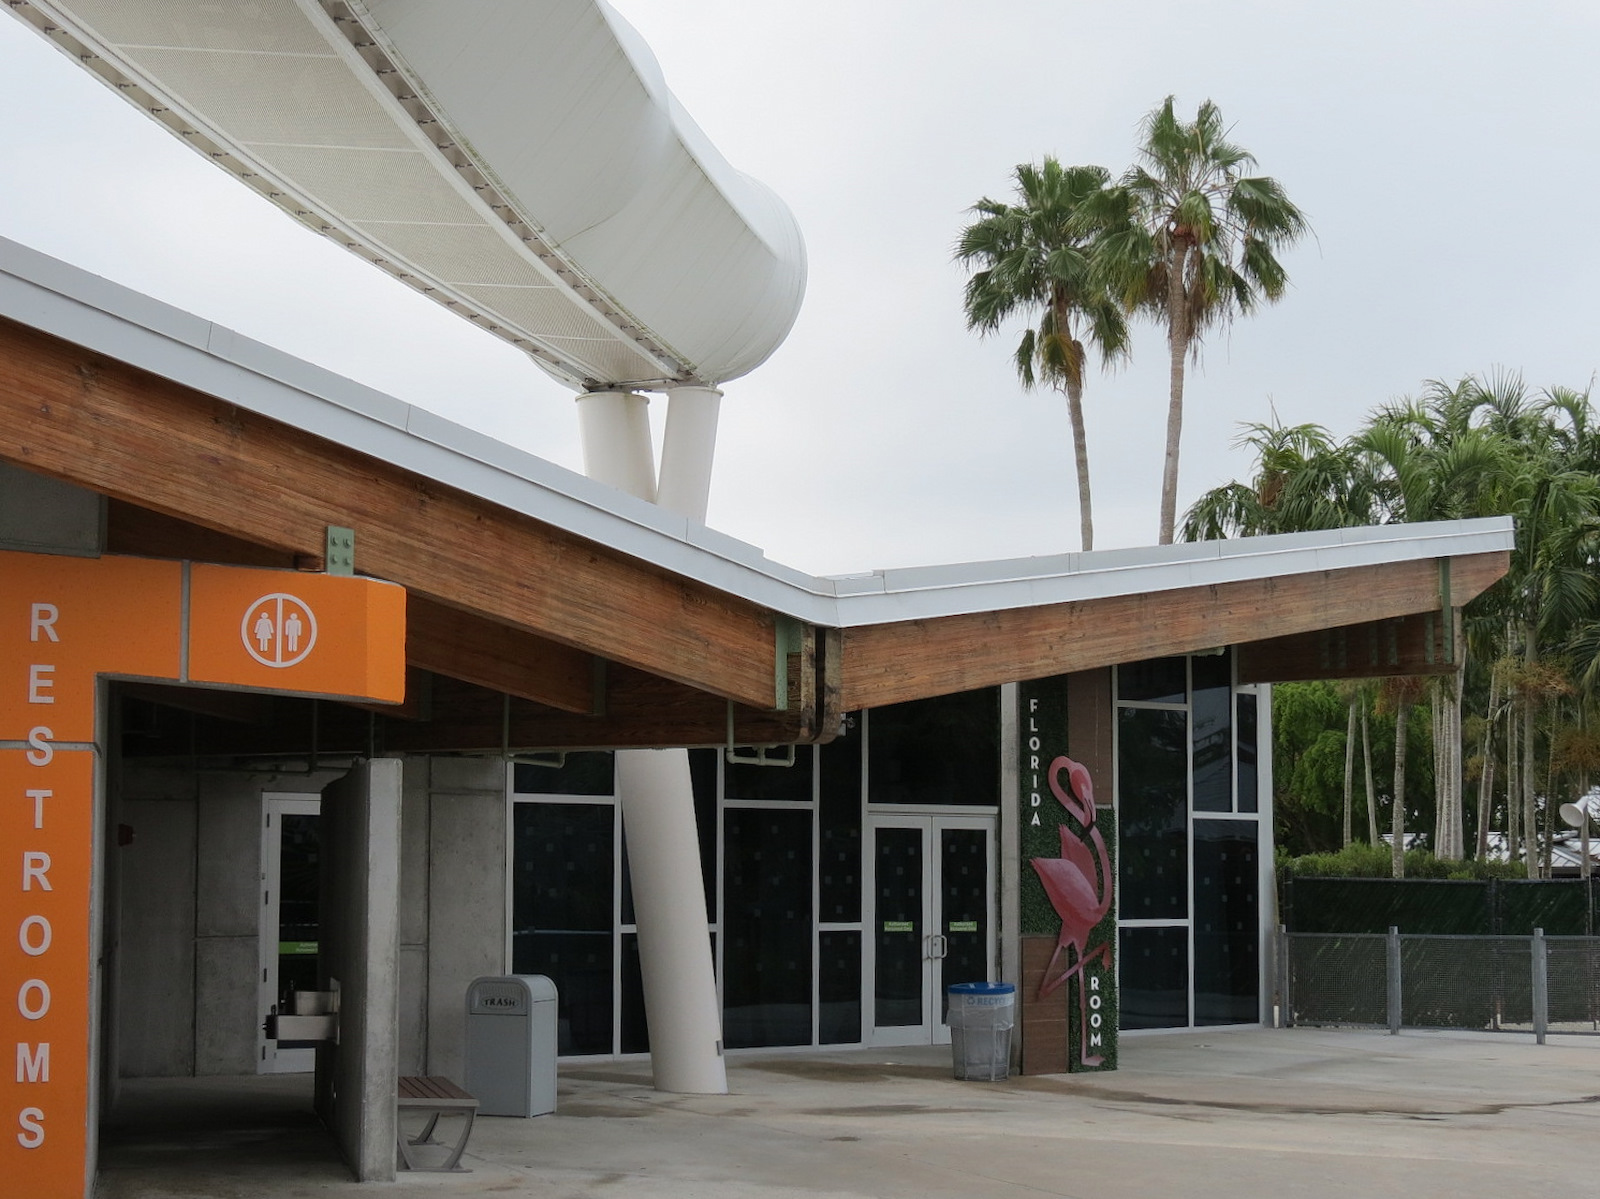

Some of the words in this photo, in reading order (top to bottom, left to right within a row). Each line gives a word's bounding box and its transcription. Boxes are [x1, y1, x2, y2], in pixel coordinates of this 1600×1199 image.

[1028, 698, 1041, 827] FLORIDA
[15, 602, 60, 1149] RESTROOMS
[484, 997, 515, 1007] TRASH
[1089, 975, 1102, 1047] ROOM
